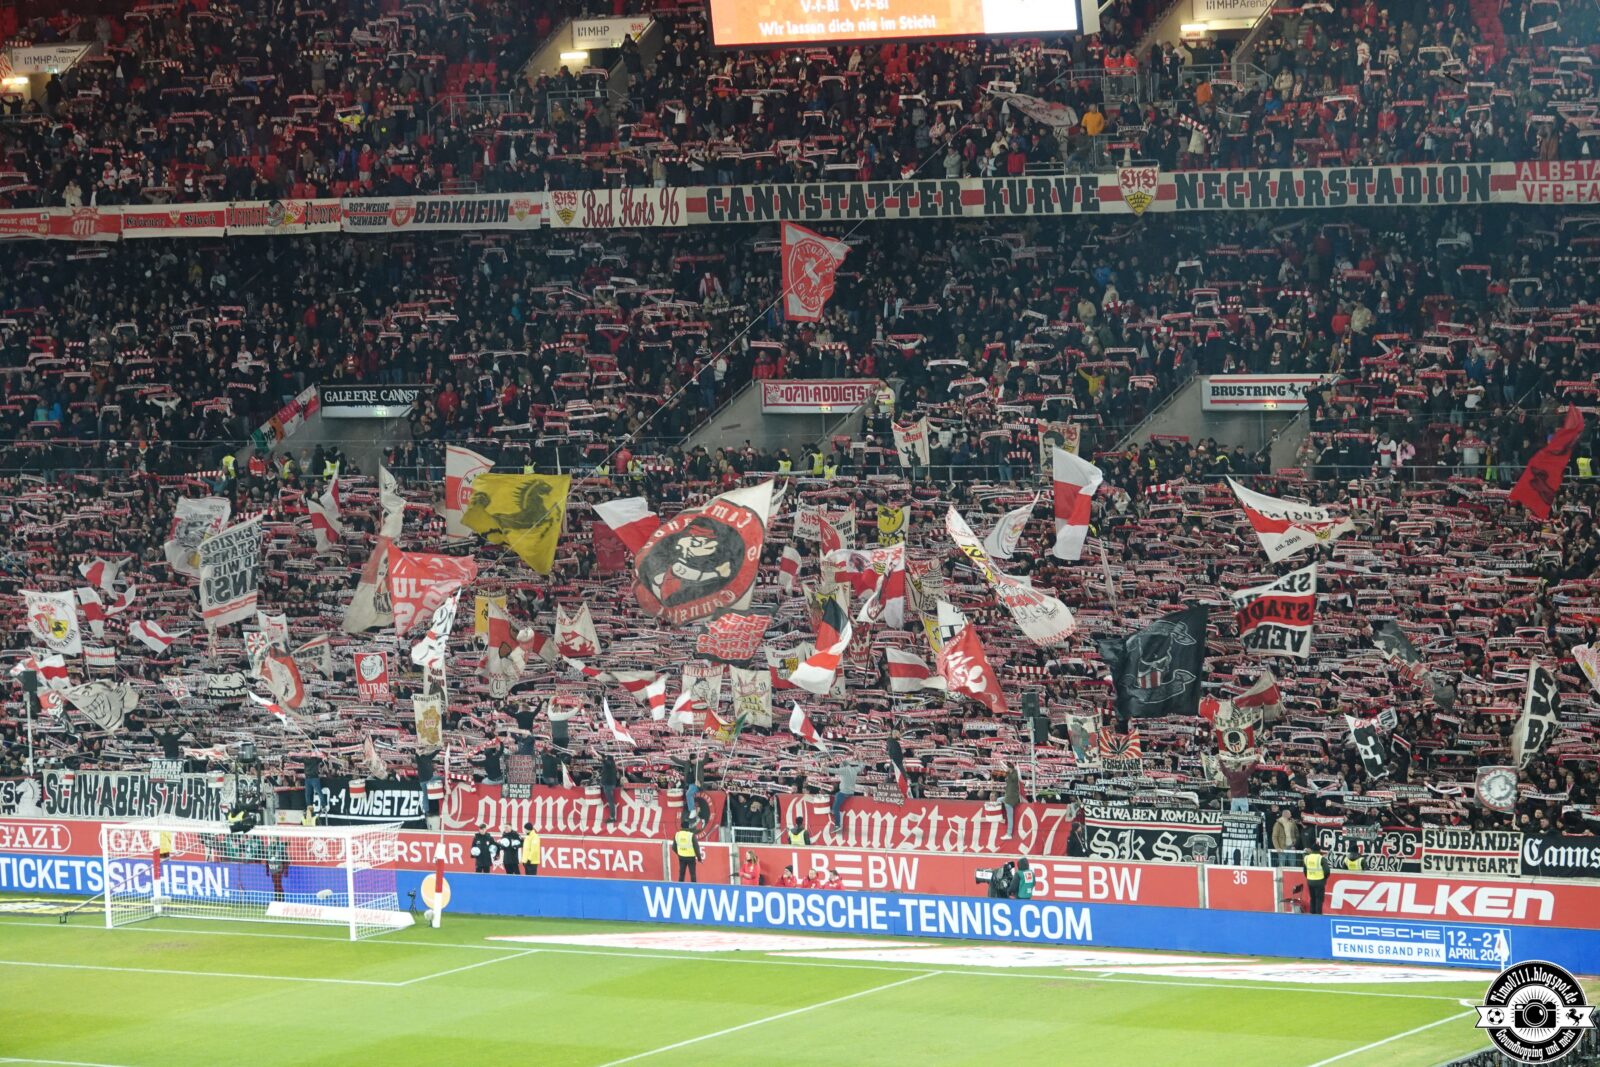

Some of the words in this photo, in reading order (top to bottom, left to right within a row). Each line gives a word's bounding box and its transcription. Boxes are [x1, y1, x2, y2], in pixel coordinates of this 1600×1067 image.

[588, 25, 610, 36] MHP
[759, 22, 783, 36] Wir
[787, 20, 825, 34] lassen
[829, 18, 854, 33] dich
[858, 17, 877, 31] nie
[880, 16, 896, 30] im
[1174, 164, 1491, 208] NECKARSTADION
[706, 178, 962, 221] CANNSTATTER
[983, 171, 1099, 217] KURVE
[412, 199, 511, 223] BERKHEIM
[582, 188, 615, 228] Red
[620, 187, 655, 226] Hots
[659, 187, 680, 225] 96
[73, 220, 95, 234] 0711
[349, 214, 388, 226] SCHWABEN
[785, 386, 809, 403] 0711
[813, 385, 865, 402] ADDICTS
[1211, 385, 1286, 397] BRUSTRING
[209, 688, 247, 697] ULTRAS
[360, 683, 388, 695] ULTRAS
[151, 760, 183, 769] ULTRAS
[45, 773, 222, 822] SCHWABENSTURM
[442, 782, 662, 838] Commando
[1084, 805, 1158, 821] SCHWABEN
[1160, 808, 1222, 824] KOMPANIE
[785, 795, 1005, 854] Cannstatt
[1016, 805, 1070, 857] 97
[1387, 832, 1417, 857] 36
[1424, 854, 1519, 873] STUTTGART
[0, 857, 103, 892] TICKETS
[109, 861, 231, 898] SICHERN!
[1232, 870, 1248, 885] 36
[1330, 879, 1554, 921] FALKEN
[642, 884, 1093, 942] WWW.PORSCHE-TENNIS.COM
[1335, 925, 1441, 940] PORSCHE
[1337, 942, 1374, 954] TENNIS
[1378, 944, 1414, 957] GRAND
[1417, 946, 1441, 959] PRIX
[1448, 948, 1479, 961] APRIL
